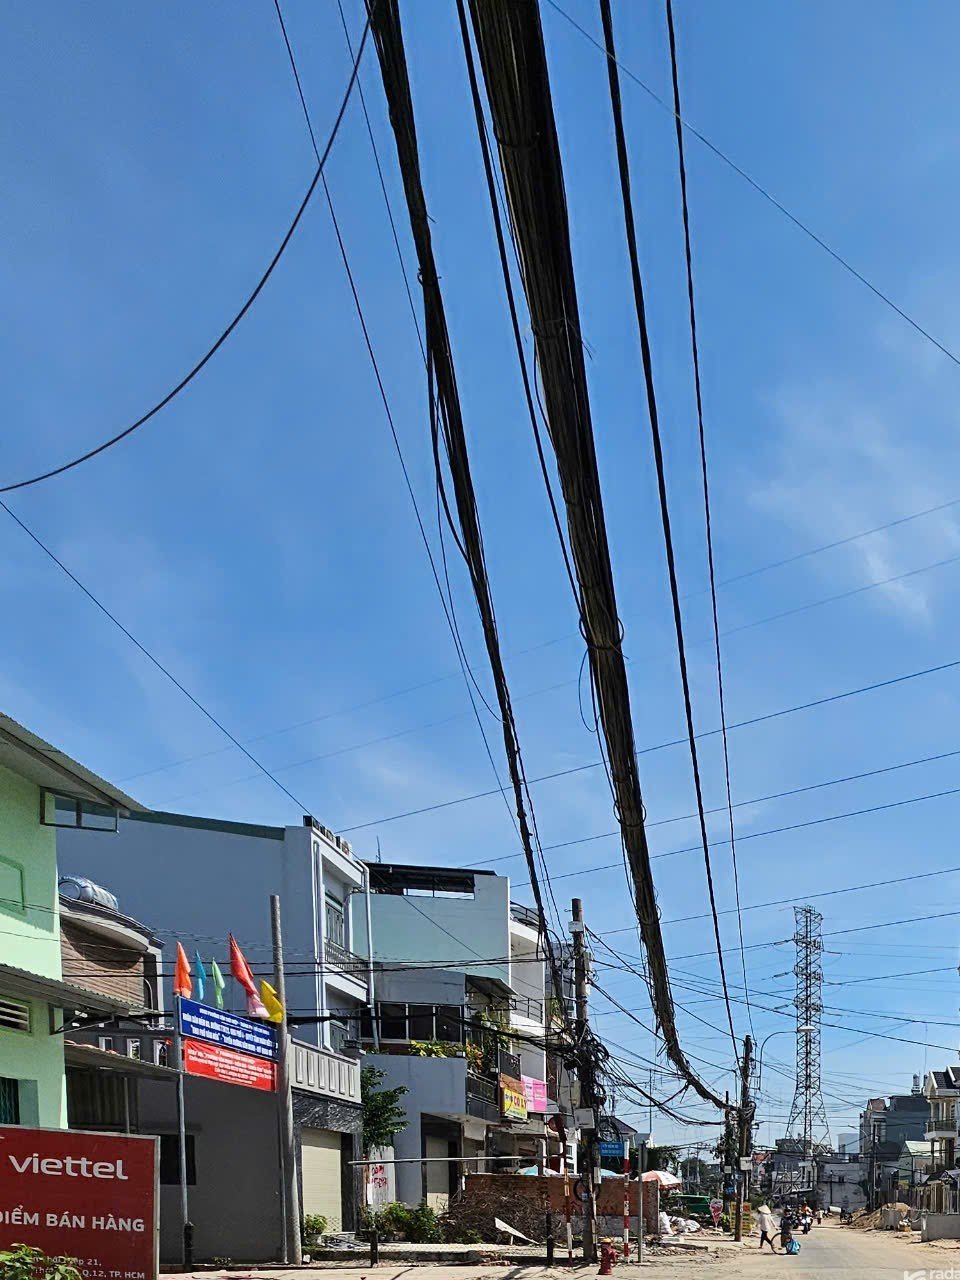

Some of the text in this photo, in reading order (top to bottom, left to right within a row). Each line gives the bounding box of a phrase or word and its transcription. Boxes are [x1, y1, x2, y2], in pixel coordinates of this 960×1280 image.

[8, 1153, 129, 1180] viettel
[46, 1211, 85, 1229] BÁN
[92, 1213, 145, 1232] HÀNG
[124, 1271, 145, 1280] HCM
